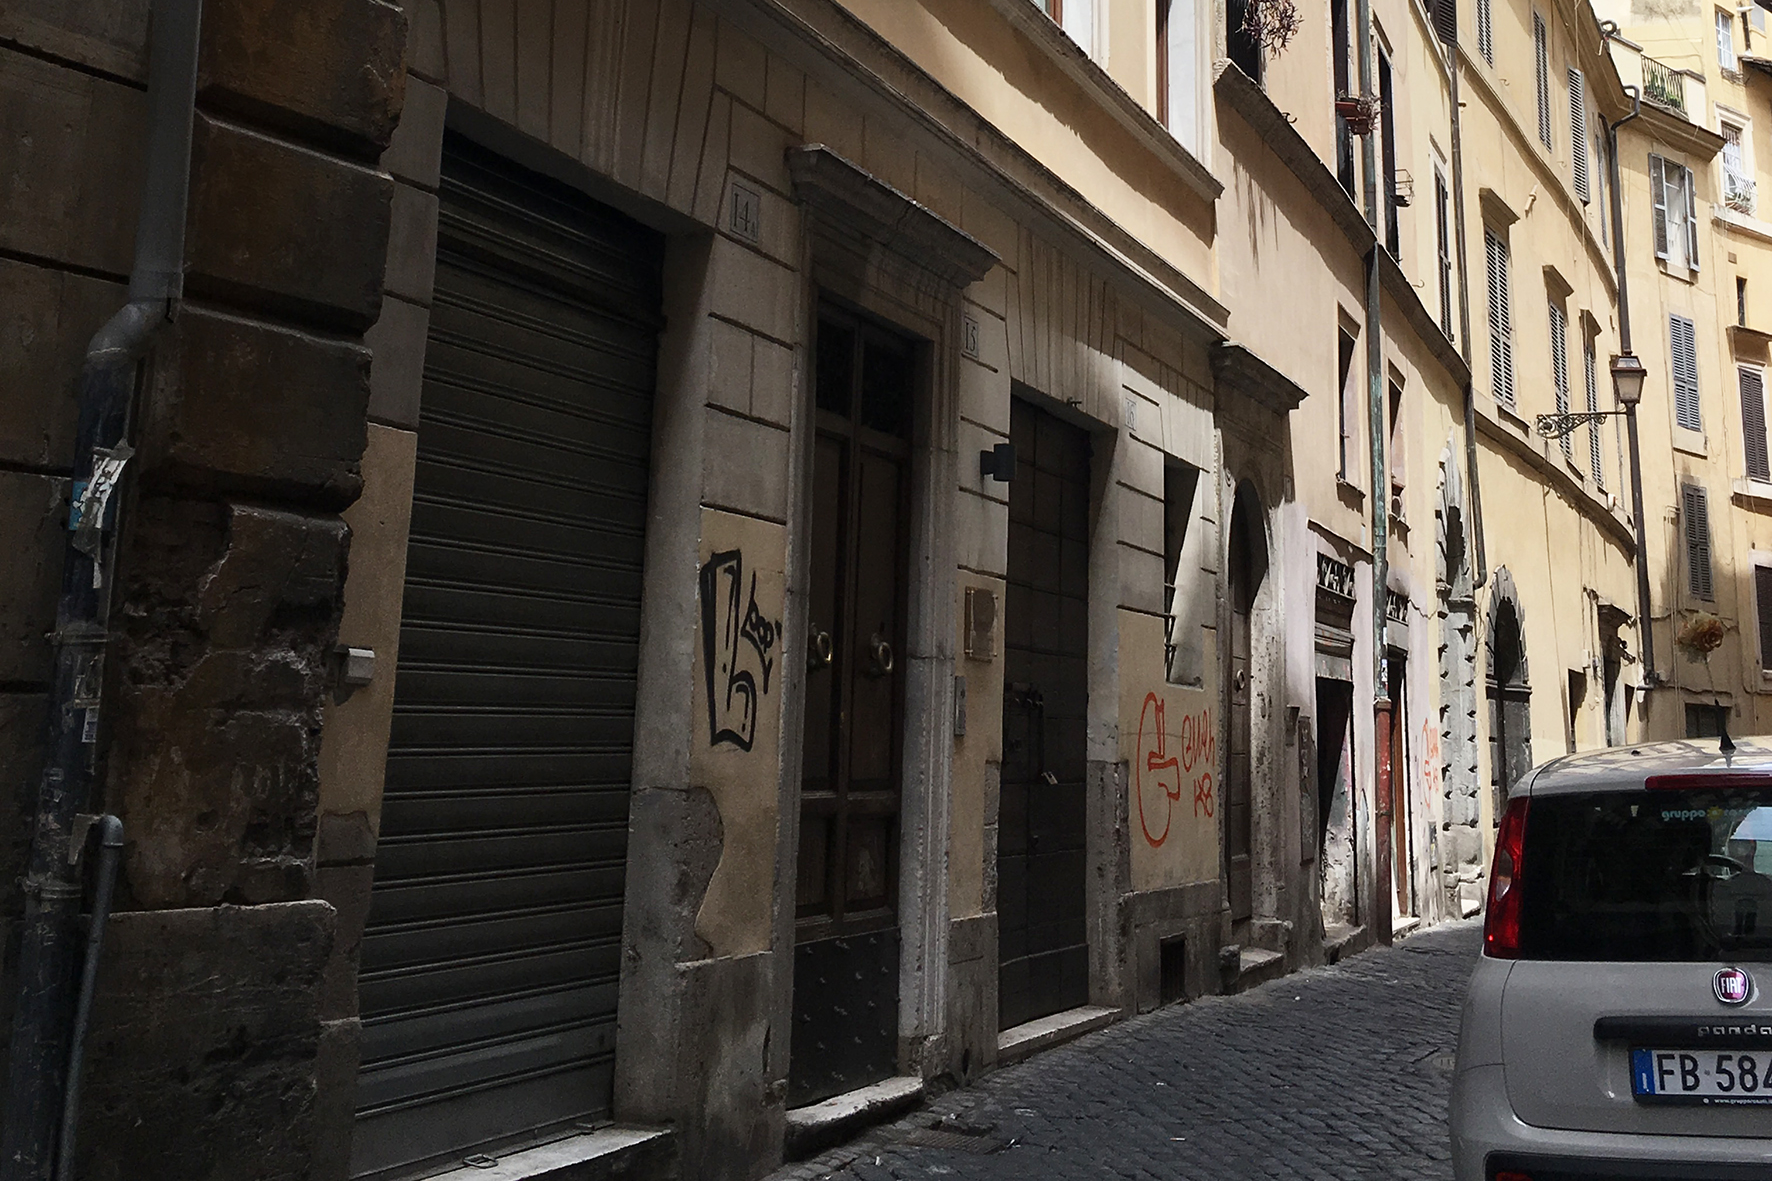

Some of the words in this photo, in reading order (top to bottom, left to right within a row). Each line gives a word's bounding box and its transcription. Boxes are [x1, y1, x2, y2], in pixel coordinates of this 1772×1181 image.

[966, 322, 976, 351] 15
[1662, 809, 1706, 821] gruppo
[1720, 977, 1743, 994] FIAT
[1698, 1025, 1772, 1036] panda
[1656, 1054, 1700, 1091] FB
